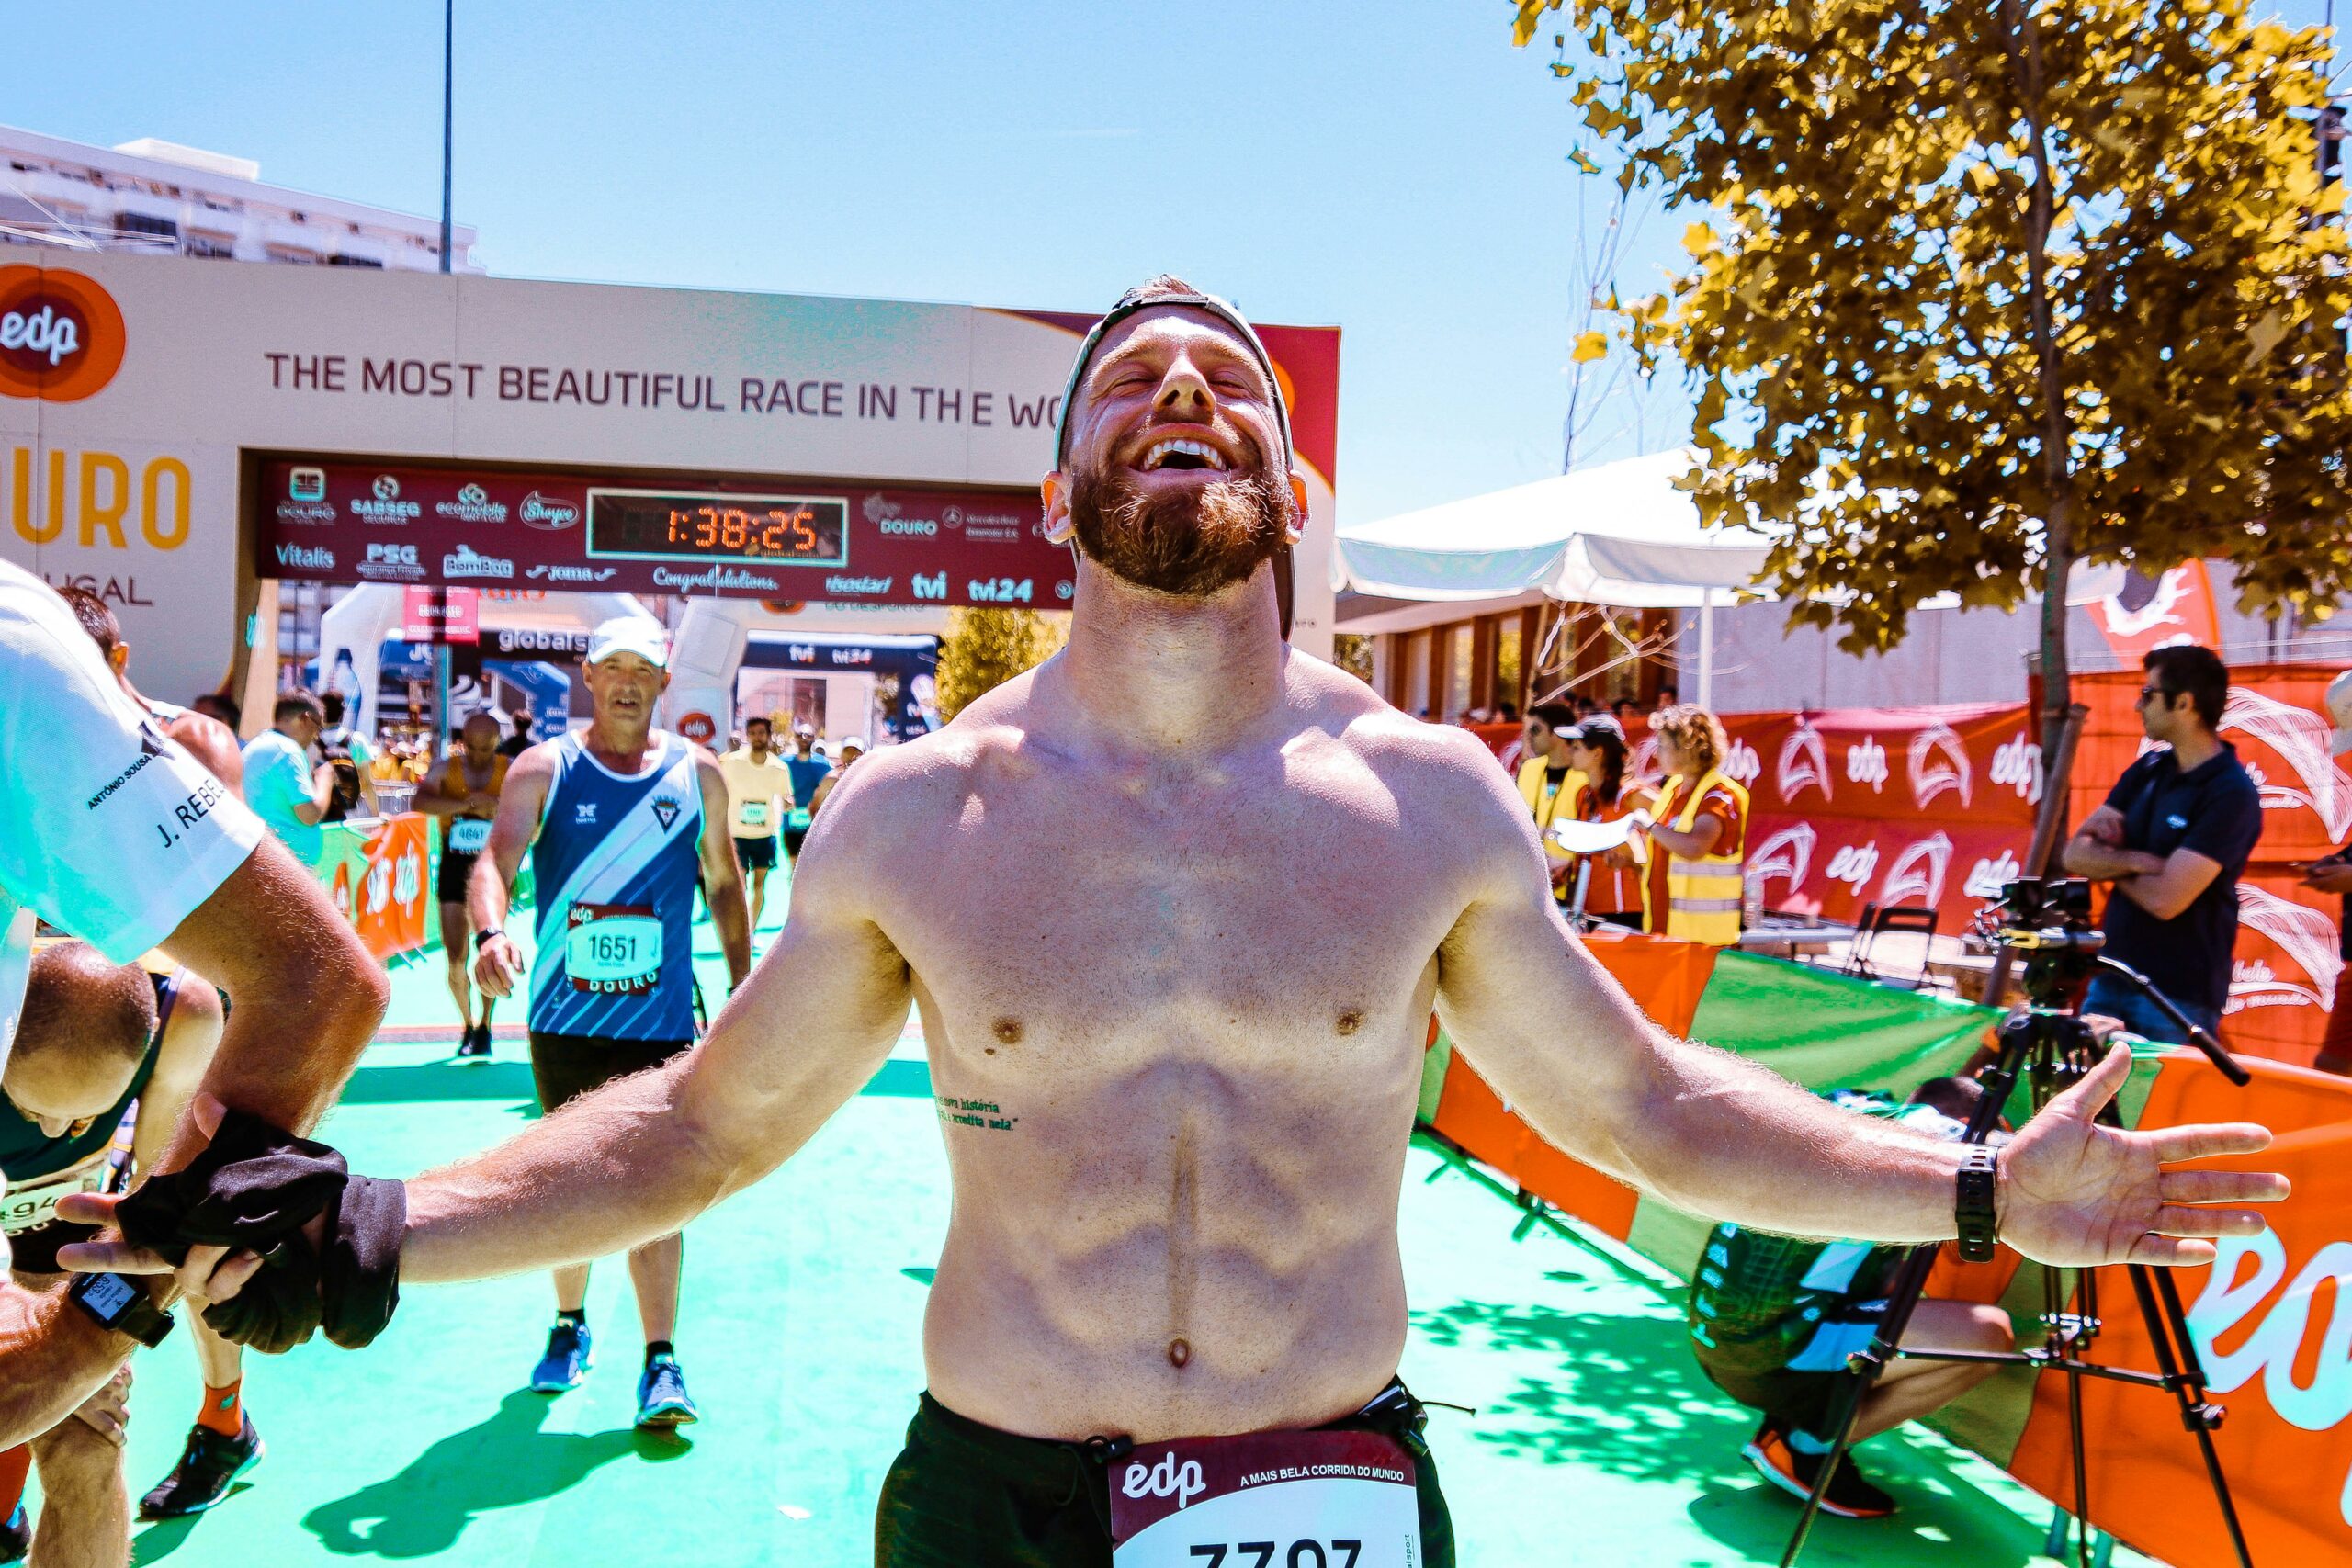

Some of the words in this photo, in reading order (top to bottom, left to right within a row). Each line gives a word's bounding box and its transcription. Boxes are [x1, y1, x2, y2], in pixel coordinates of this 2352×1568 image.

[0, 305, 79, 367] edp
[264, 352, 347, 392] THE
[361, 358, 483, 399] MOST
[497, 364, 725, 413] BEAUTIFUL
[740, 377, 844, 418] RACE
[858, 382, 897, 420] IN
[910, 385, 993, 426] THE
[668, 507, 816, 549] 1:38:25
[879, 518, 939, 536] DOURO
[276, 542, 336, 569] Vitalis
[367, 543, 418, 565] PSG
[911, 571, 947, 600] tvi
[967, 578, 1034, 603] tvi24
[87, 775, 126, 810] ANTÓNIO
[123, 754, 153, 780] SOUSA
[157, 823, 180, 849] J.
[588, 934, 637, 962] 1651
[589, 970, 659, 993] DOURO
[1122, 1451, 1206, 1509] edp
[1240, 1476, 1250, 1487] A
[1250, 1470, 1278, 1485] MAIS
[1280, 1466, 1310, 1479] BELA
[1311, 1464, 1356, 1476] CORRIDA
[1357, 1466, 1371, 1477] DO
[1372, 1467, 1405, 1482] MUNDO
